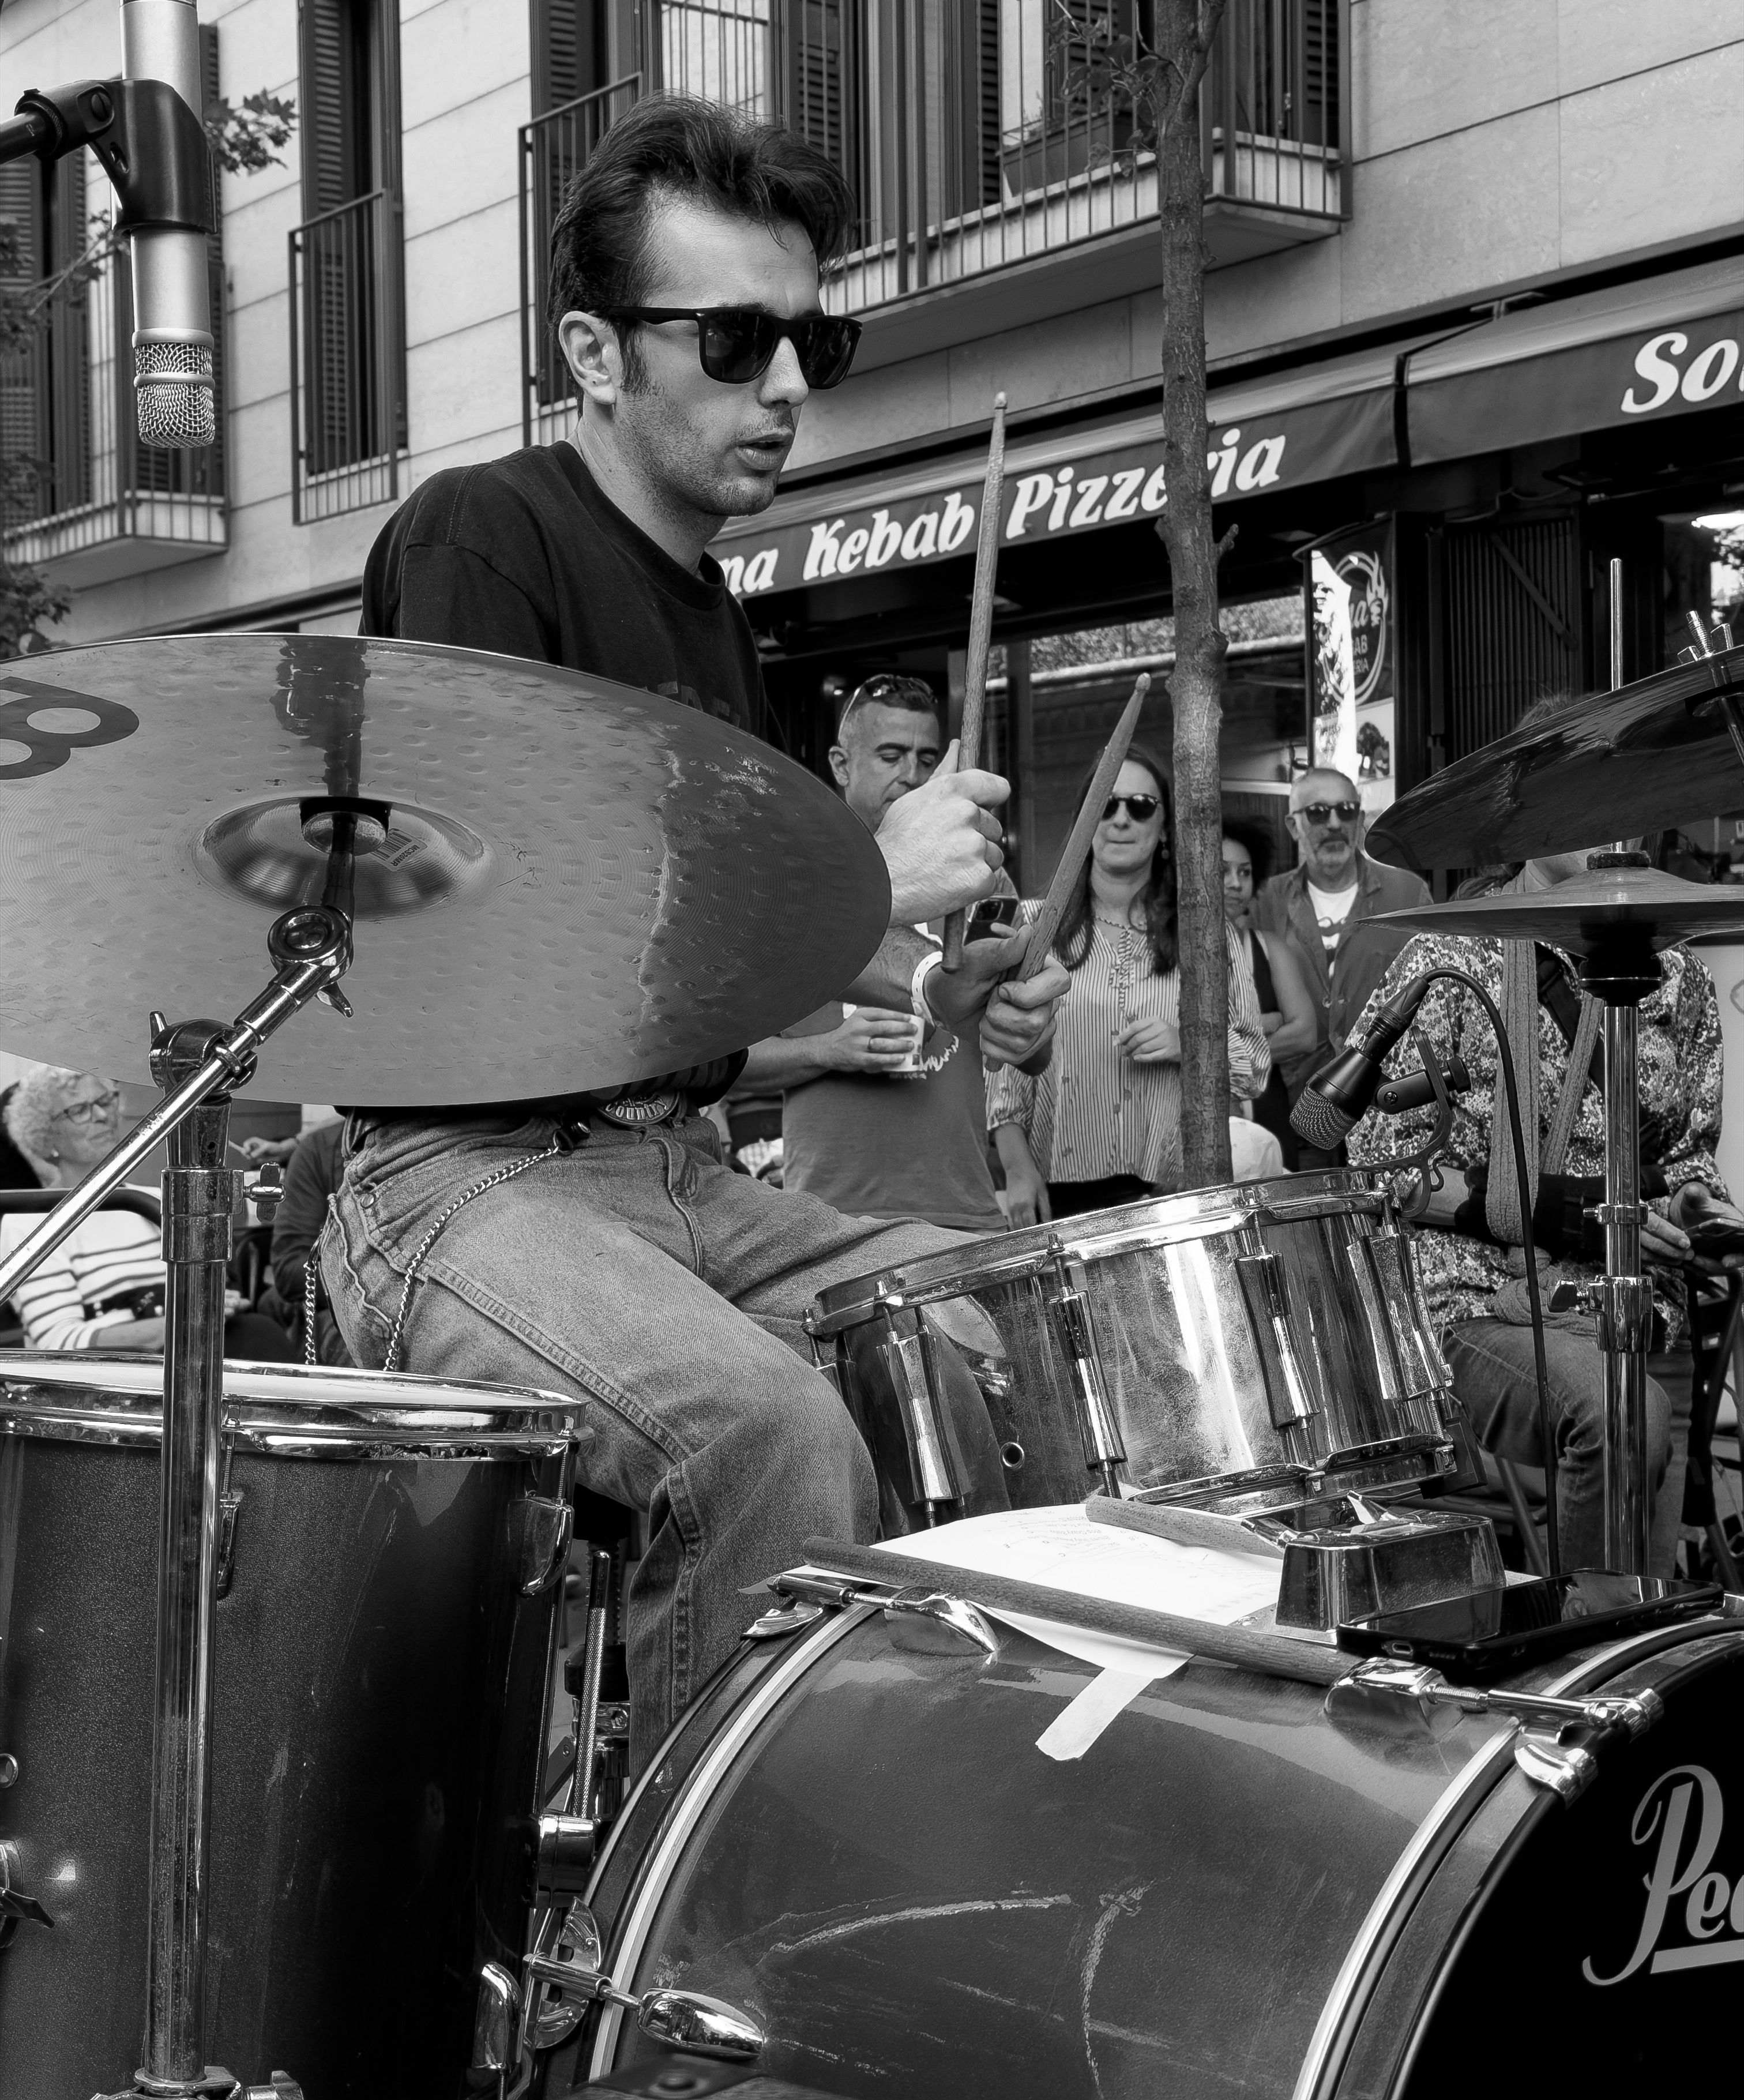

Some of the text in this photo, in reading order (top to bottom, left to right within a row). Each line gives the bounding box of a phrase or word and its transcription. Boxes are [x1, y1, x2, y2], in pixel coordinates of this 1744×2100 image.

[1621, 332, 1744, 414] So
[803, 492, 975, 581] Kebab
[1006, 429, 1286, 539] Pizzeia
